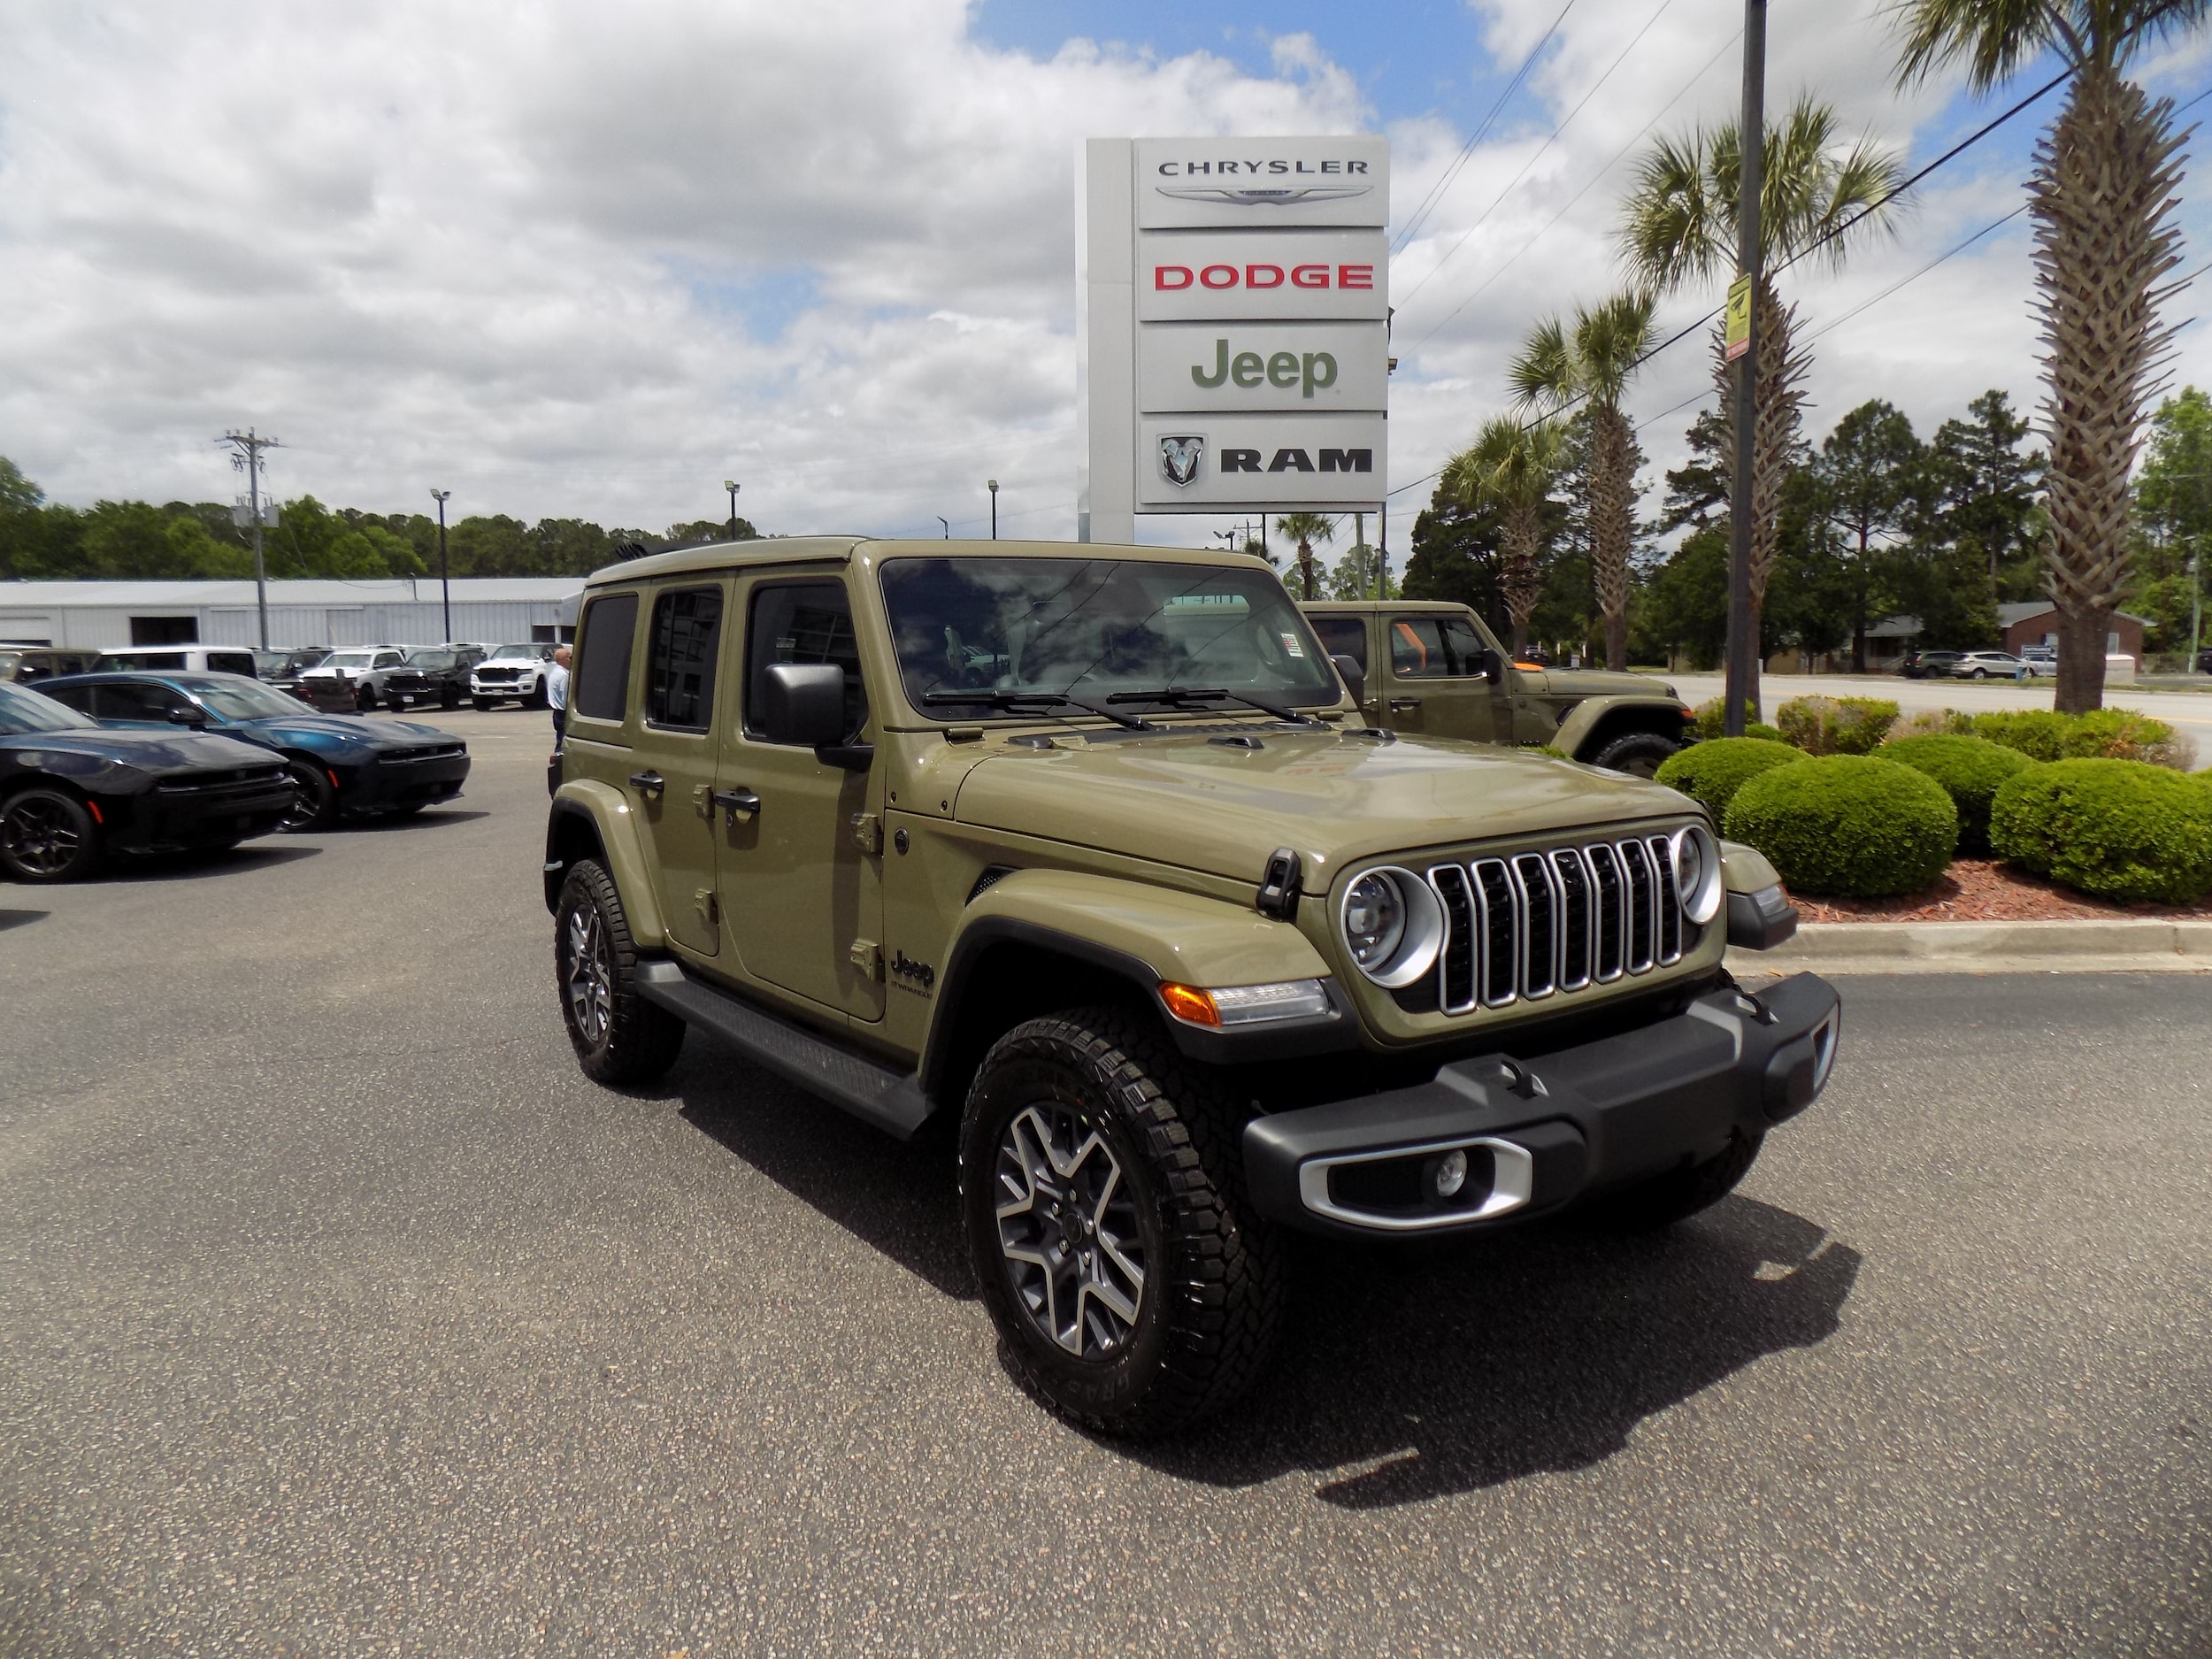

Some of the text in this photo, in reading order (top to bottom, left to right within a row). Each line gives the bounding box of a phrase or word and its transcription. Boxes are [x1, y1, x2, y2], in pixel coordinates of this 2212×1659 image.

[1158, 160, 1369, 176] CHRYSLER
[1155, 265, 1373, 290] DODGE
[1191, 339, 1338, 398] Jeep
[1220, 449, 1372, 472] RAM
[891, 949, 934, 987] Jeep
